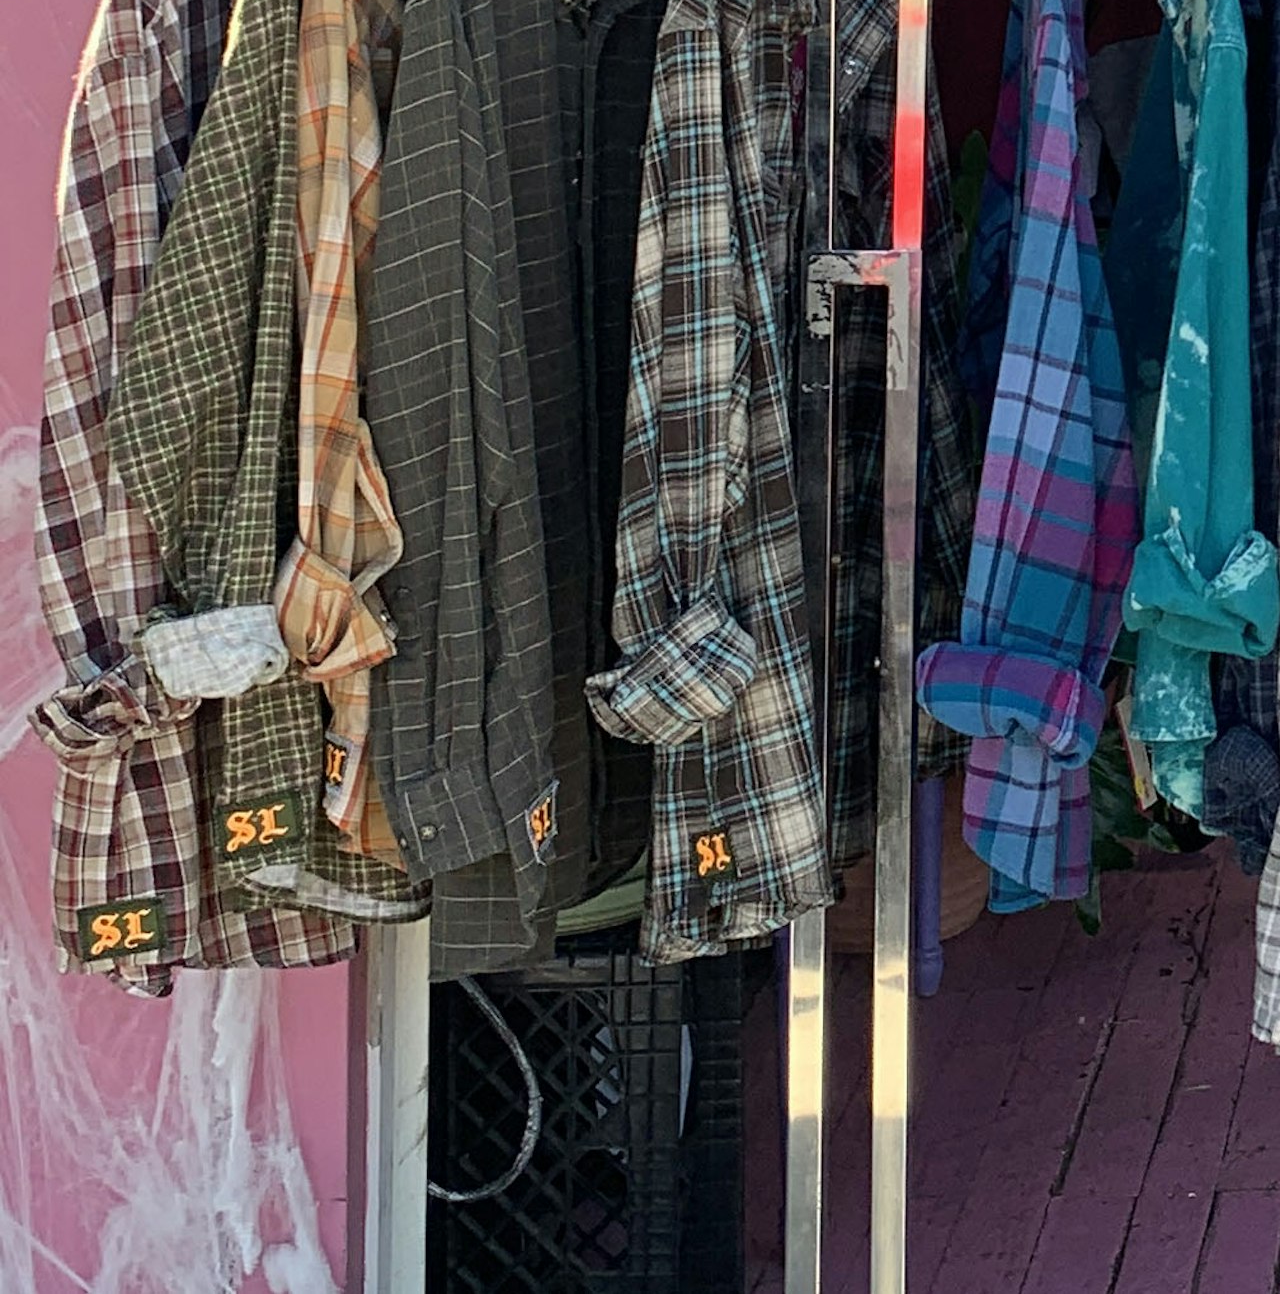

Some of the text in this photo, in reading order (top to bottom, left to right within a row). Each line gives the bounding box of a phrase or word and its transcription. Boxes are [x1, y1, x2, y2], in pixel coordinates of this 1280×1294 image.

[226, 804, 288, 852] SL
[696, 833, 732, 876] SL
[90, 909, 155, 956] SL
